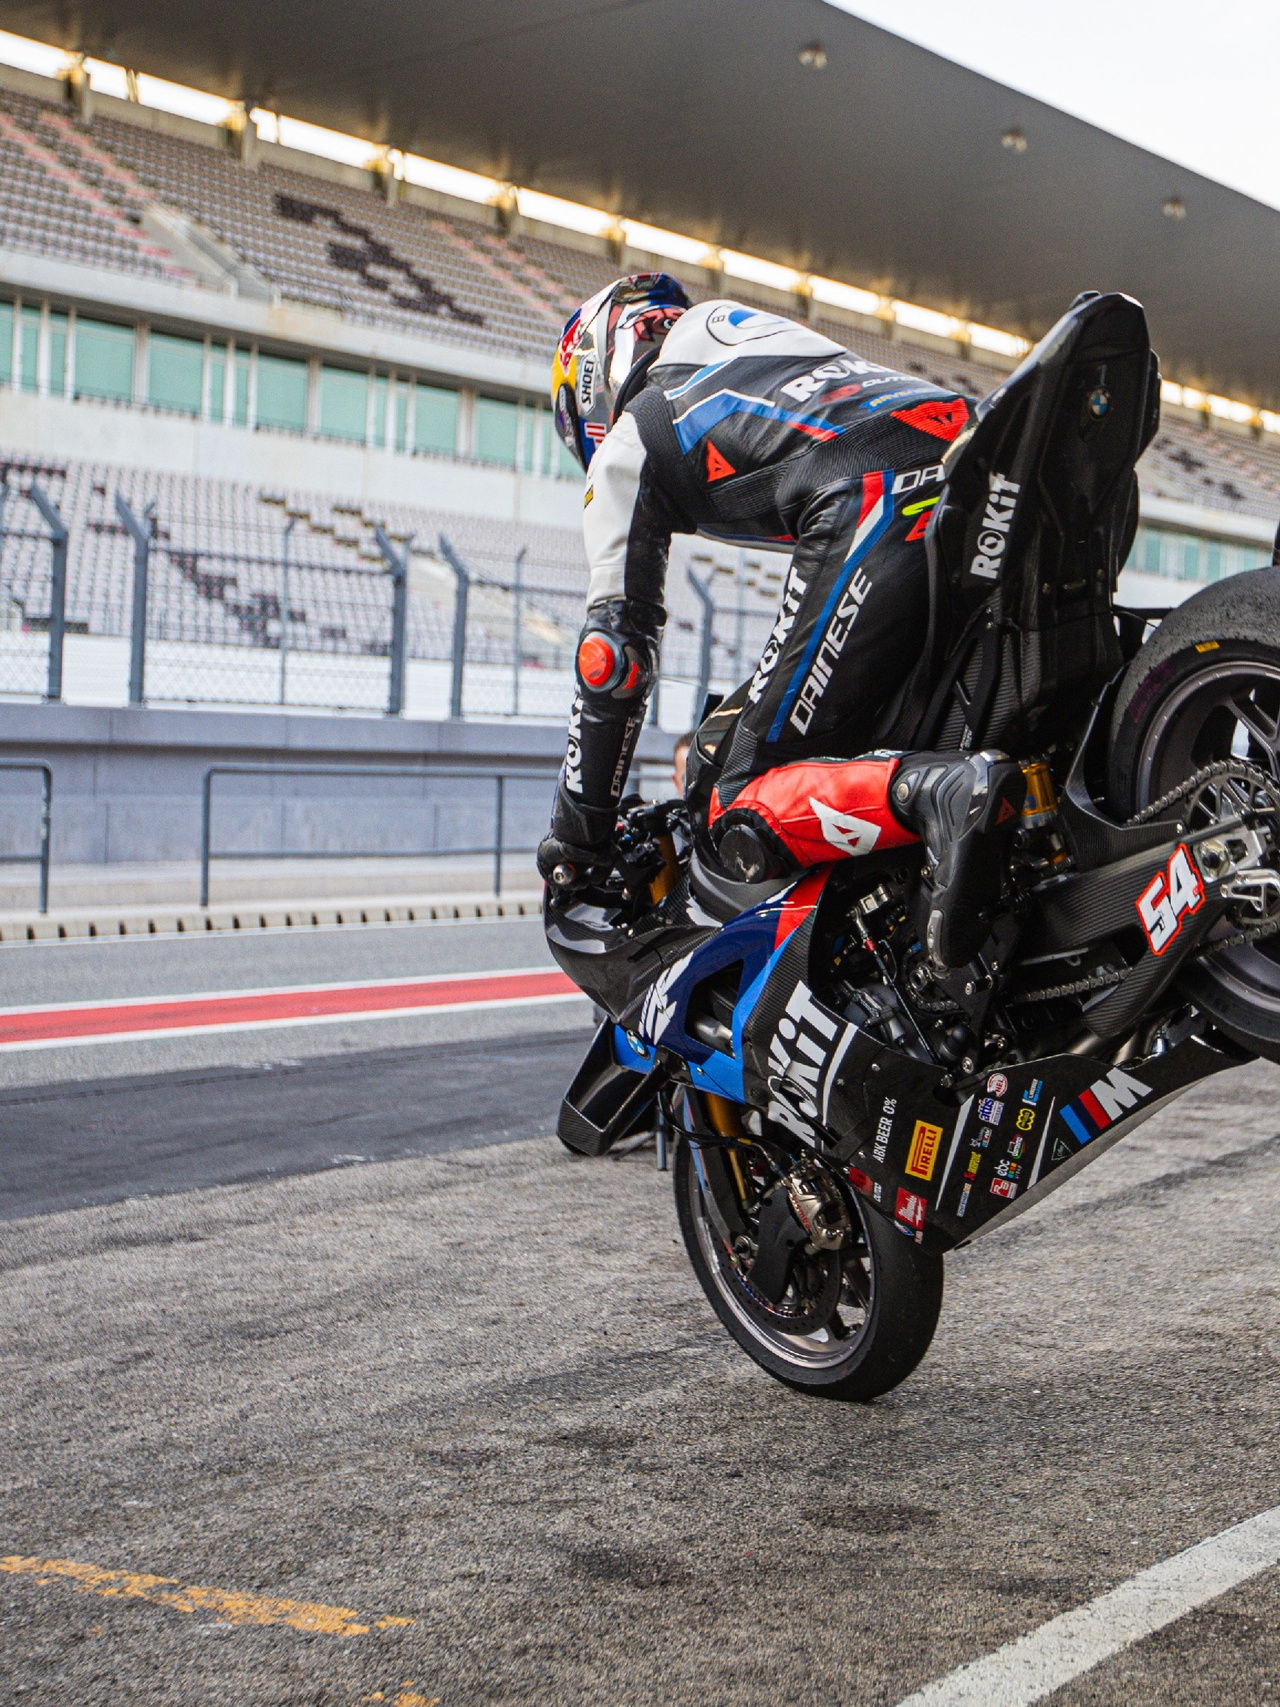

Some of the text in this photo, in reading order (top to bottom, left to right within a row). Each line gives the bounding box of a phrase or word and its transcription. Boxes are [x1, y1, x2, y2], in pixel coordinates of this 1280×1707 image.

[581, 359, 597, 404] SHOEI
[789, 568, 872, 736] DAINESE
[610, 716, 636, 798] DAINESE
[1135, 847, 1206, 956] 54
[768, 980, 839, 1148] ROKiT
[872, 1097, 897, 1163] ABK BEER 0%
[910, 1126, 938, 1176] PIRELLI
[994, 1159, 1010, 1177] ebc
